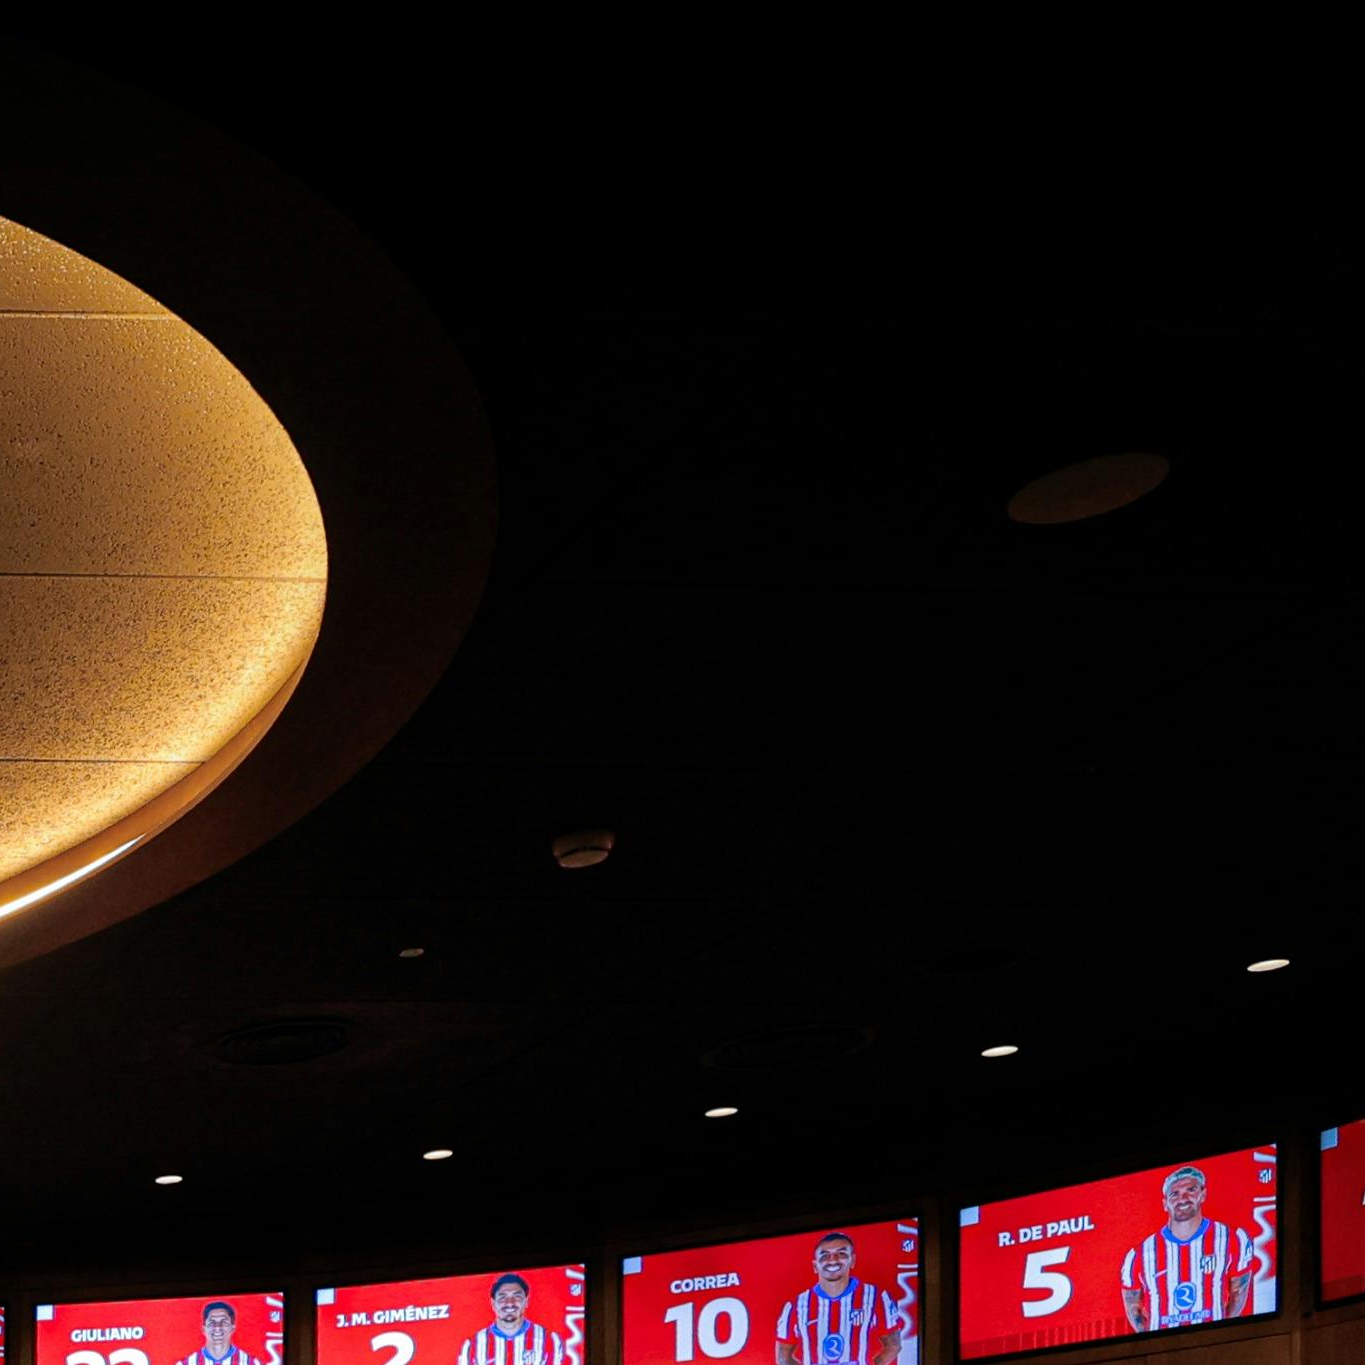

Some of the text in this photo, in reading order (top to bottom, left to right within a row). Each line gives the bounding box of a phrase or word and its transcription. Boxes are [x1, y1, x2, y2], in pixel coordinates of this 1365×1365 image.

[998, 1215, 1095, 1247] R. DE PAUL
[670, 1272, 740, 1294] CORREA
[1022, 1246, 1072, 1318] 5
[336, 1304, 450, 1328] J. M. GIMÉNEZ
[664, 1297, 749, 1362] 10
[70, 1326, 144, 1343] GIULIANO
